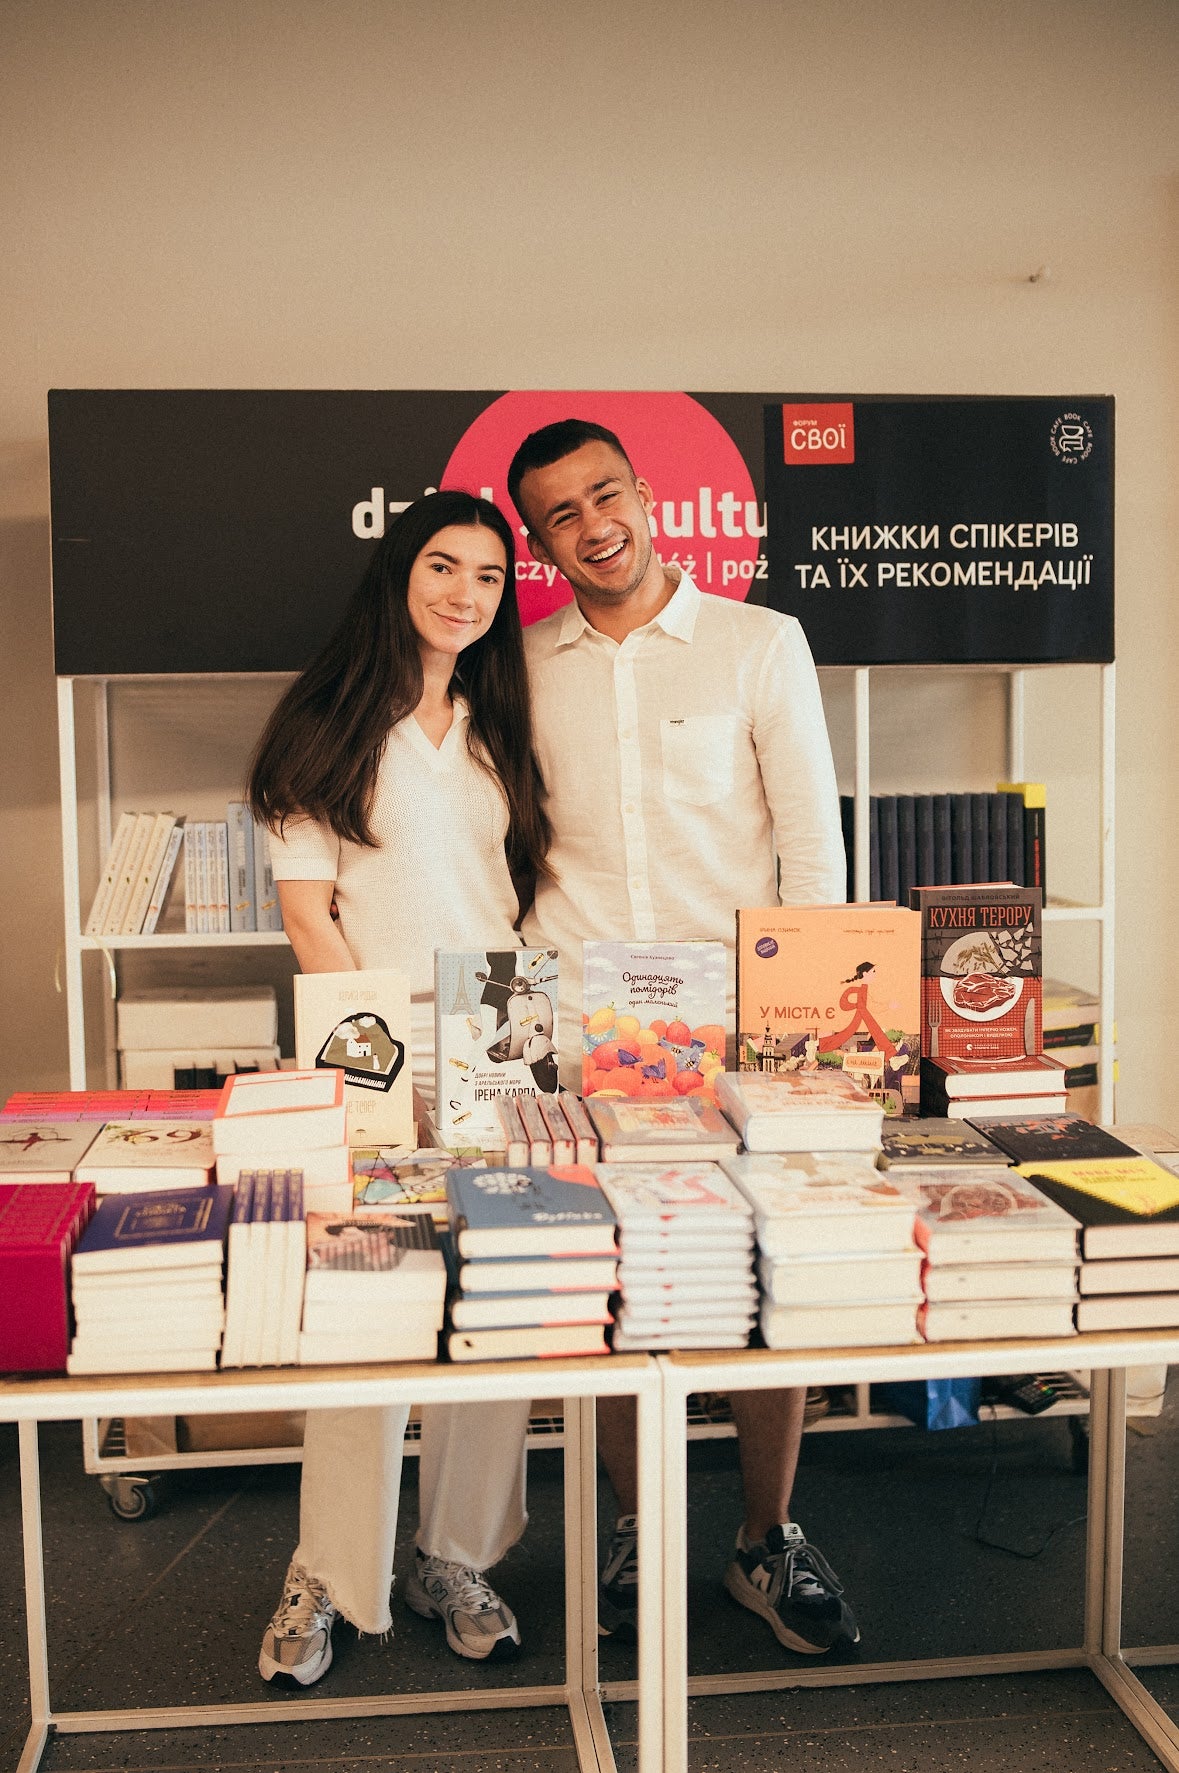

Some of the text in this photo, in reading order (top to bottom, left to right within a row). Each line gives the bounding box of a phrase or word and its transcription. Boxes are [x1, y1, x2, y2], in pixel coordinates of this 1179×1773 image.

[790, 423, 846, 450] СВОЇ
[811, 523, 1079, 551] КНИЖКИ СПІКЕРІВ
[515, 560, 567, 587] czy
[722, 553, 769, 586] poż
[794, 554, 1094, 591] ТА ЇХ РЕКОМЕНДАЦІЇ
[930, 906, 1032, 928] КУХНЯ ТЕРОРУ
[622, 971, 684, 986] Одинадцять
[630, 983, 679, 999] помідорів
[760, 1006, 770, 1019] У
[774, 1006, 821, 1019] МІСТА
[825, 1007, 836, 1019] Є
[474, 1088, 501, 1101] ІРЕНА
